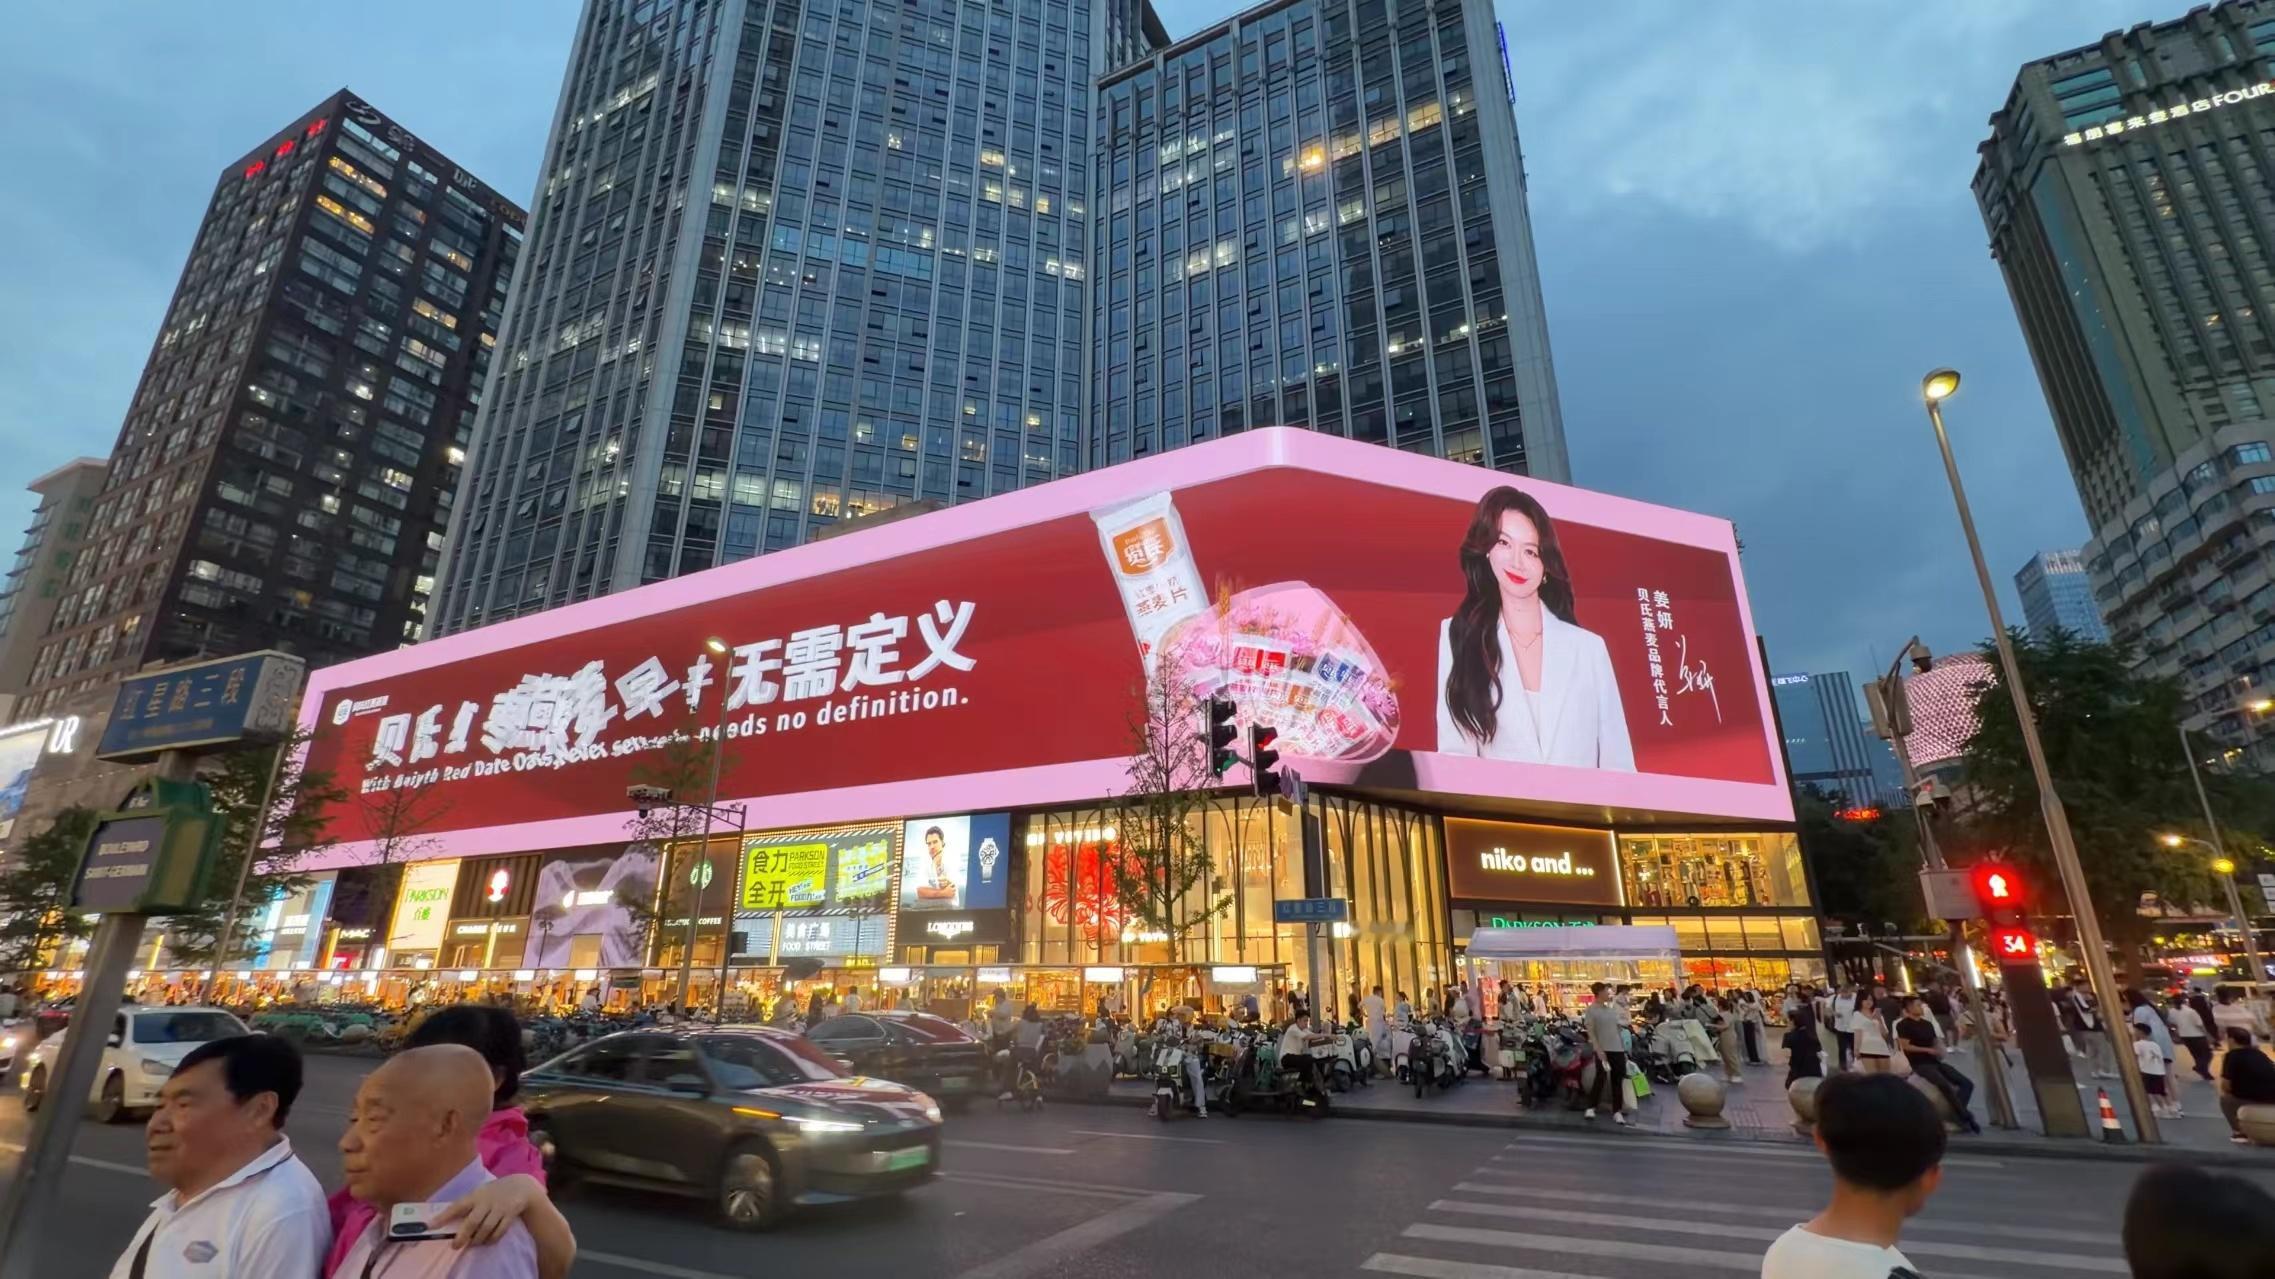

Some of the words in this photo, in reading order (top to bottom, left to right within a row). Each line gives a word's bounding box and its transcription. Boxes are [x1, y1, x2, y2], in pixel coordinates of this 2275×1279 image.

[2211, 82, 2274, 108] FOUR
[1637, 587, 1673, 726] 贝氏燕麦品牌代言人
[48, 714, 80, 754] UR
[474, 756, 512, 777] Date
[776, 710, 807, 732] no
[816, 687, 970, 726] definition.
[753, 850, 788, 875] 食力
[789, 850, 825, 861] PARKSON
[1480, 847, 1527, 872] niko
[1531, 852, 1572, 875] and
[748, 880, 786, 905] 全开
[782, 941, 800, 952] FOOD
